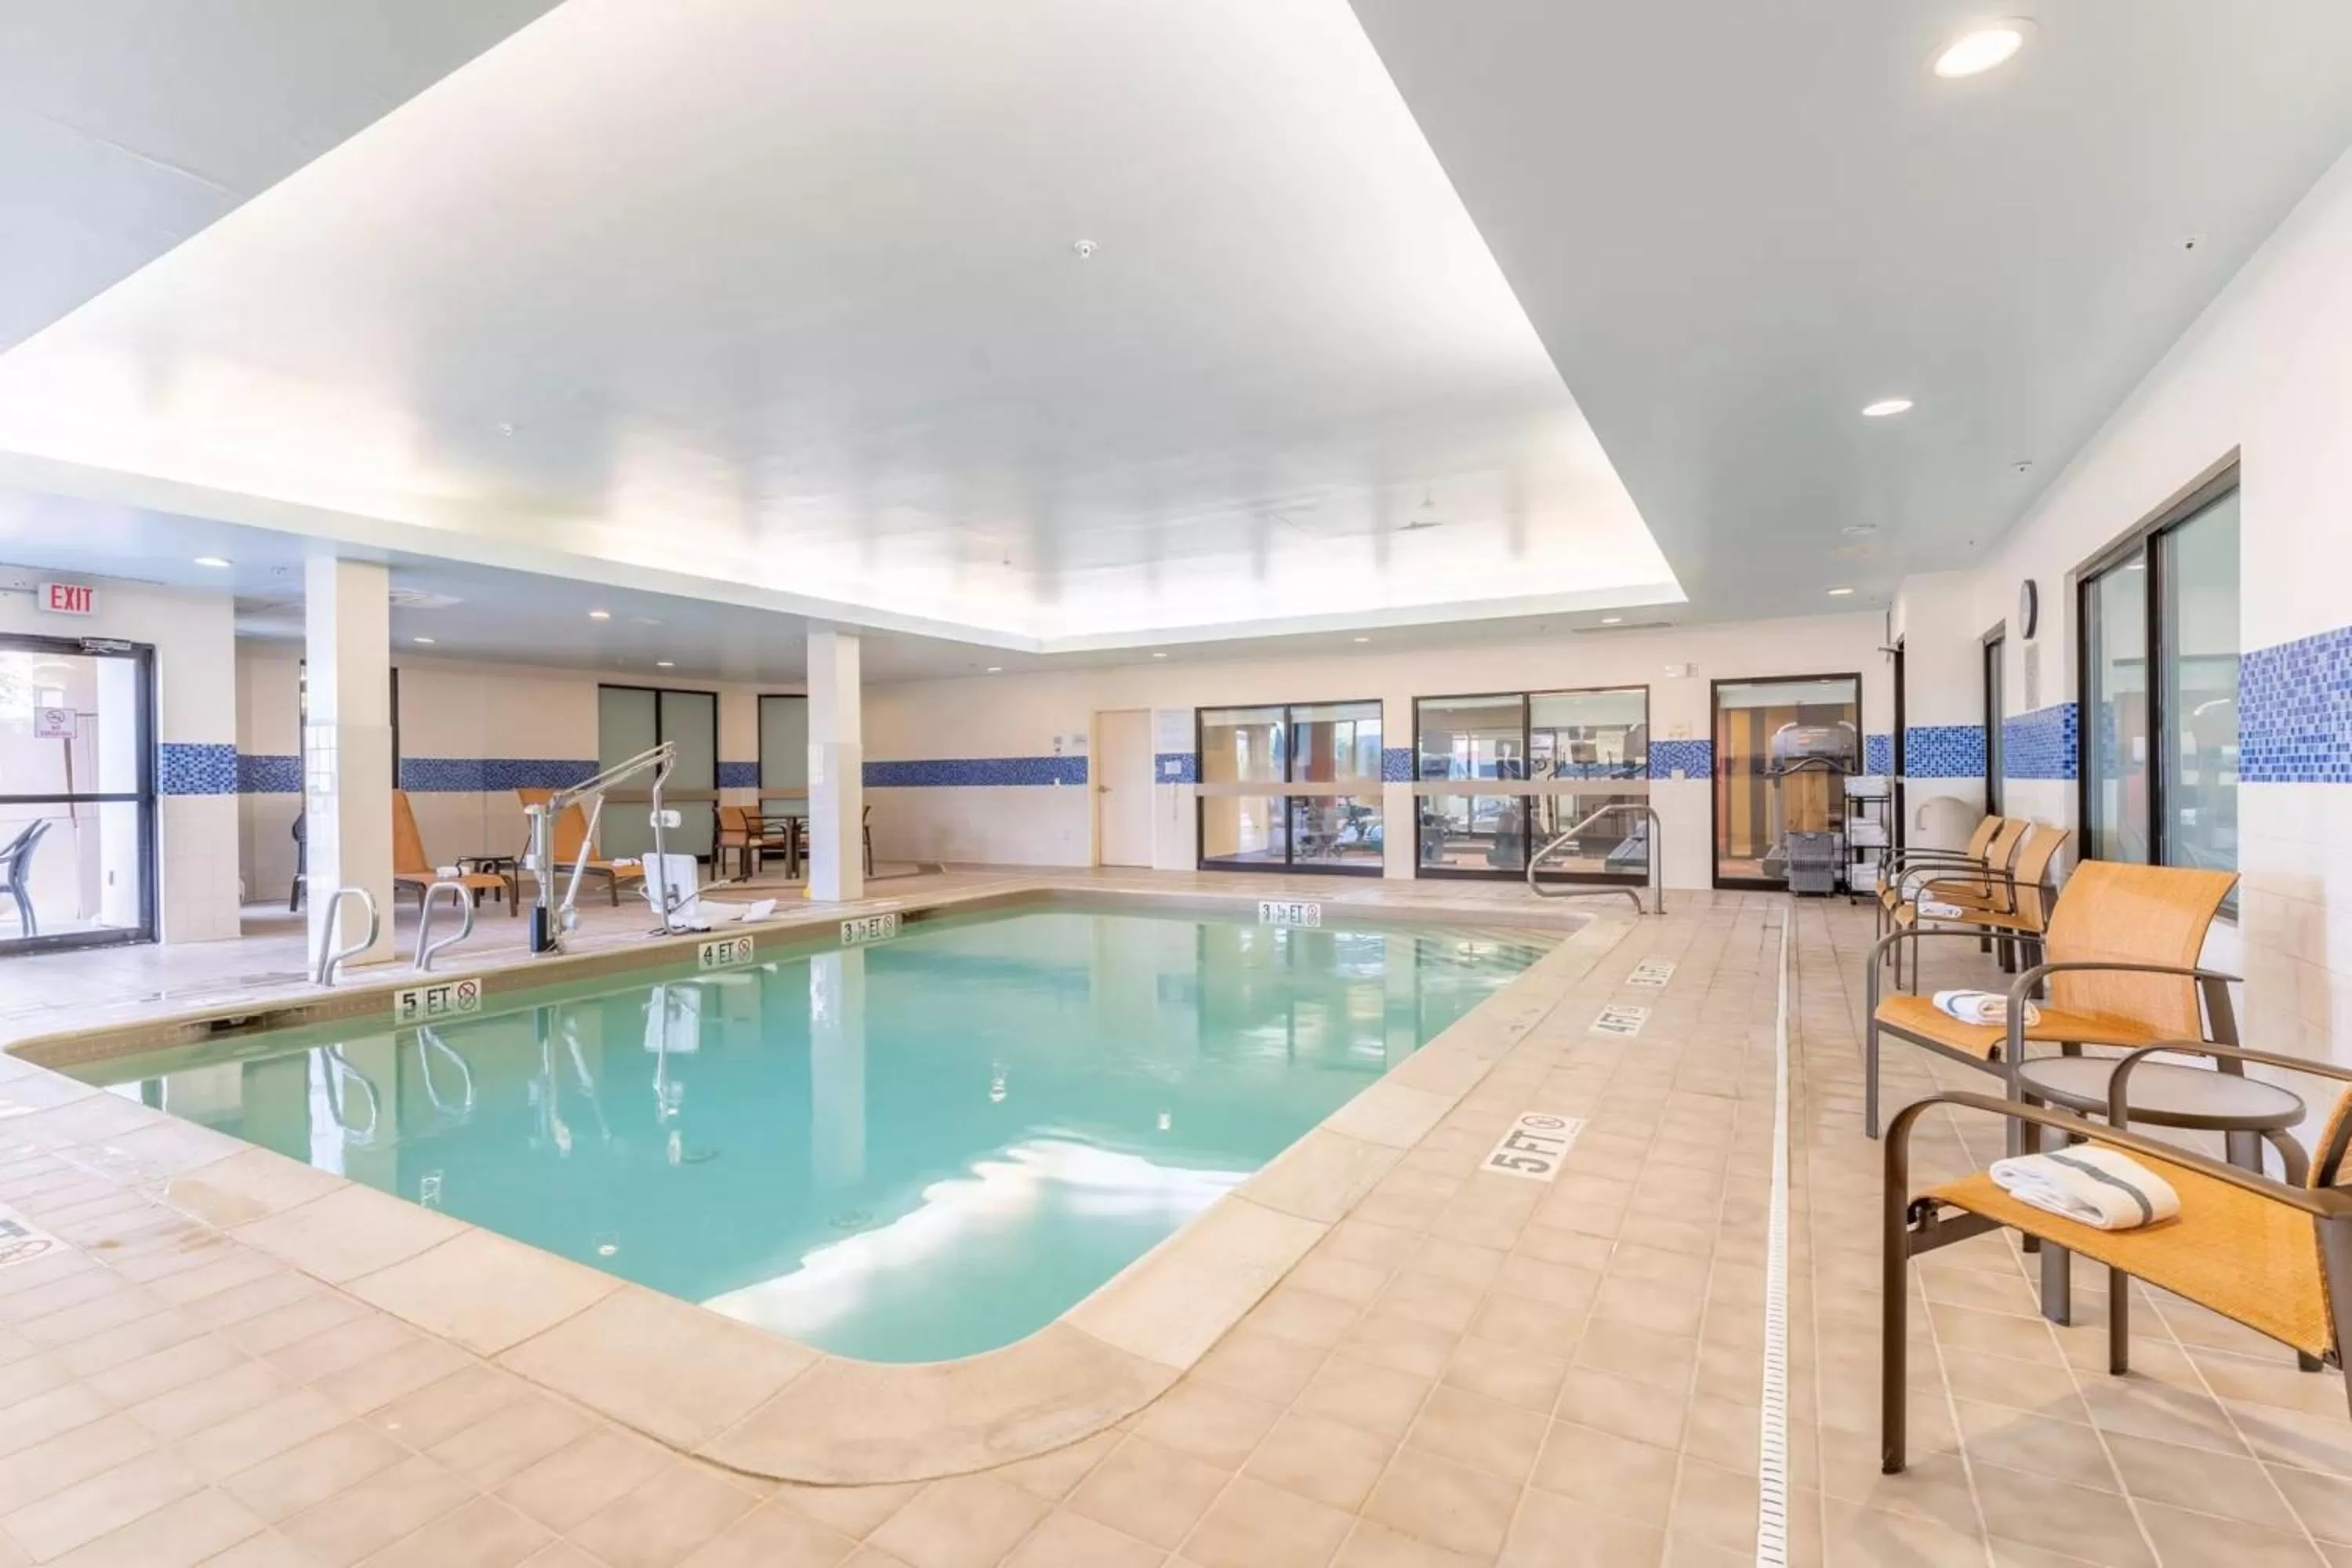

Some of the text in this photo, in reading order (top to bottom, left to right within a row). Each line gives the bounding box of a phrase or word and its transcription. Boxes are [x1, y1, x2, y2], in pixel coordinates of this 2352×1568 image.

[52, 586, 93, 612] EXIT
[703, 946, 713, 962] 4
[402, 992, 416, 1010] 5
[1490, 1128, 1566, 1174] 5 FT
